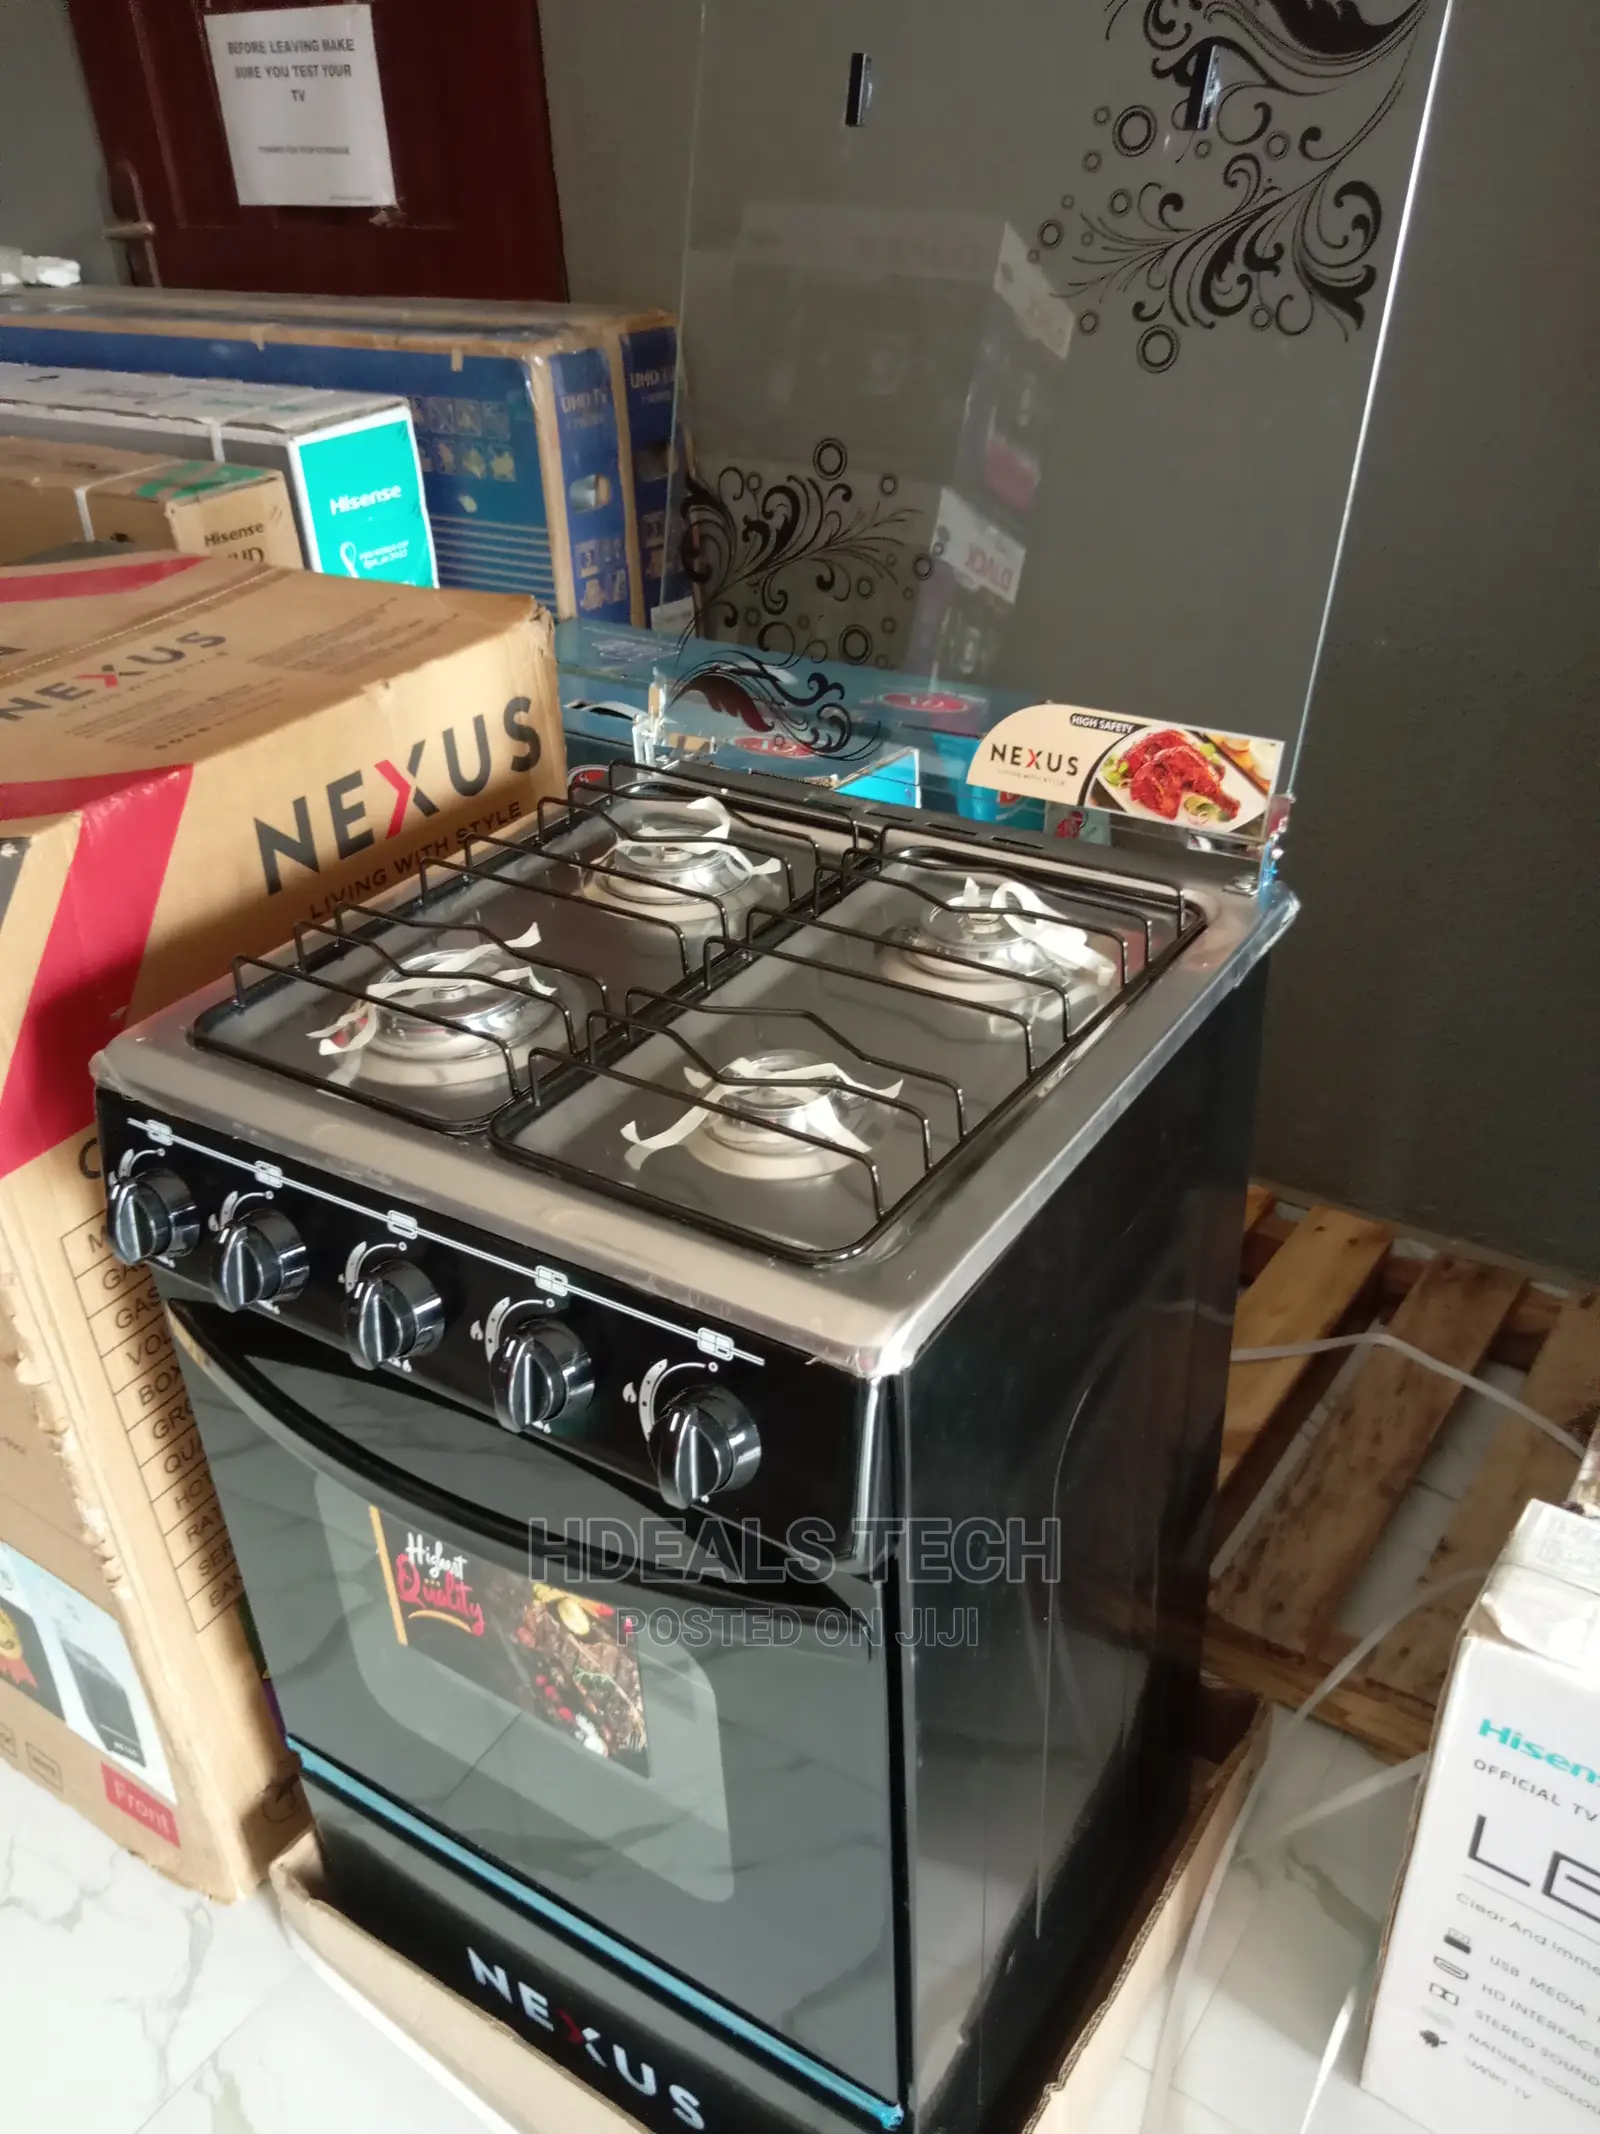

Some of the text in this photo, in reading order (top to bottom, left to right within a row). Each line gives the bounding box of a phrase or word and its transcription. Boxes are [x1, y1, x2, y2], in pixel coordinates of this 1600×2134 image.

[227, 38, 354, 54] BEFORE LEAVING MAKE
[264, 66, 289, 78] YOU
[292, 64, 318, 77] TEST
[321, 64, 352, 77] YOUR
[290, 89, 305, 101] TV
[329, 485, 402, 516] Hisense
[204, 522, 265, 548] Hisense
[0, 631, 226, 721] NEXUS
[1071, 715, 1133, 734] HIGH SAFETY
[990, 743, 1079, 777] NEXUS
[253, 696, 542, 896] NEXUS
[309, 801, 522, 920] LIVING WITH STYLE
[1478, 1718, 1600, 1788] Hisen
[113, 1778, 170, 1836] Front
[1473, 1758, 1598, 1822] OFFICIAL TV
[1456, 1893, 1507, 1922] Clear
[1509, 1921, 1548, 1945] And
[1482, 1983, 1506, 2001] HD
[1489, 1955, 1587, 2016] USB MEDIA
[466, 1946, 705, 2131] NEXUS
[1475, 2009, 1535, 2048] STEREO
